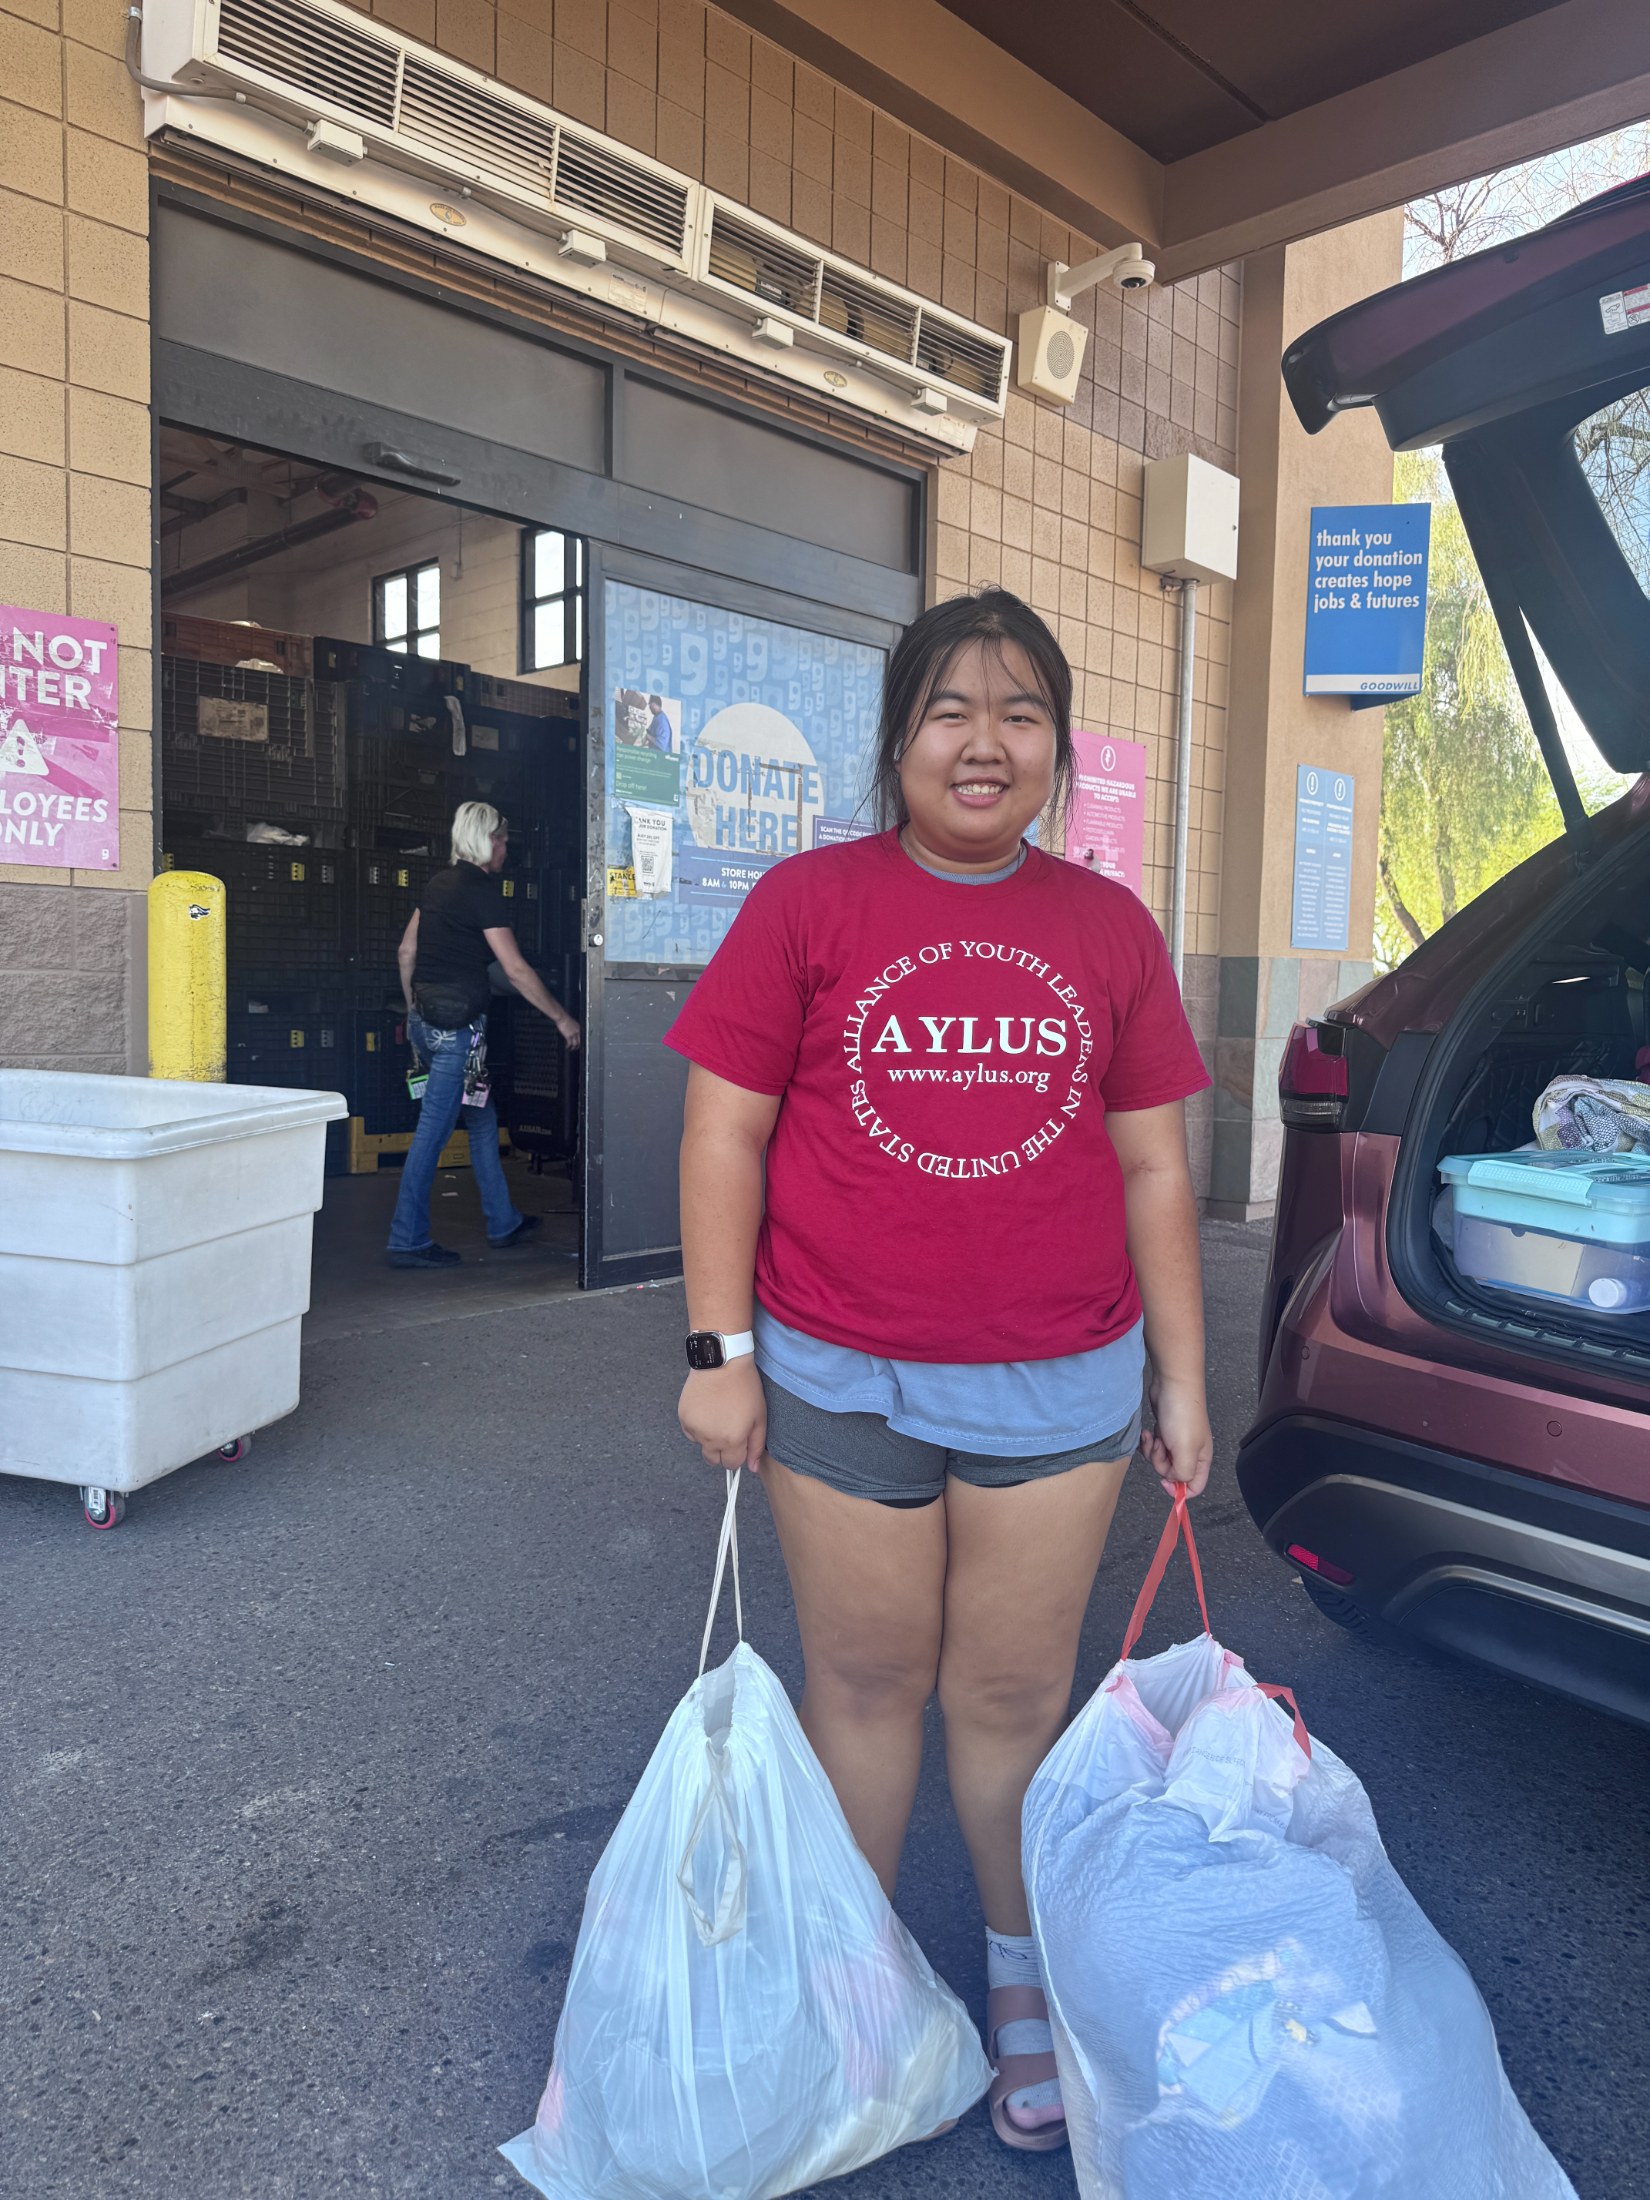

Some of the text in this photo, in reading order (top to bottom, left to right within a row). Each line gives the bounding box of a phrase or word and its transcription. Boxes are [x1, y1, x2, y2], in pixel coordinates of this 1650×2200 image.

[1317, 528, 1392, 549] thank you
[1315, 549, 1423, 572] your donation
[1315, 570, 1412, 591] creates hope
[1313, 591, 1420, 613] jobs & futures
[12, 626, 108, 675] NOT
[0, 664, 92, 710] TER
[1360, 681, 1419, 690] GOODWILL
[692, 748, 819, 805] DONATE
[0, 818, 64, 847] NLY
[652, 819, 666, 827] YOU
[715, 804, 798, 854] HERE
[702, 877, 720, 888] 8AM
[729, 880, 749, 890] 10PM
[721, 867, 746, 879] STORE
[871, 1014, 1067, 1057] AYLUS
[843, 940, 1093, 1179] ALLIANCE OF YOUTH LEADERS IN THE UNITED STATES
[887, 1063, 1051, 1093] www.aylus.org
